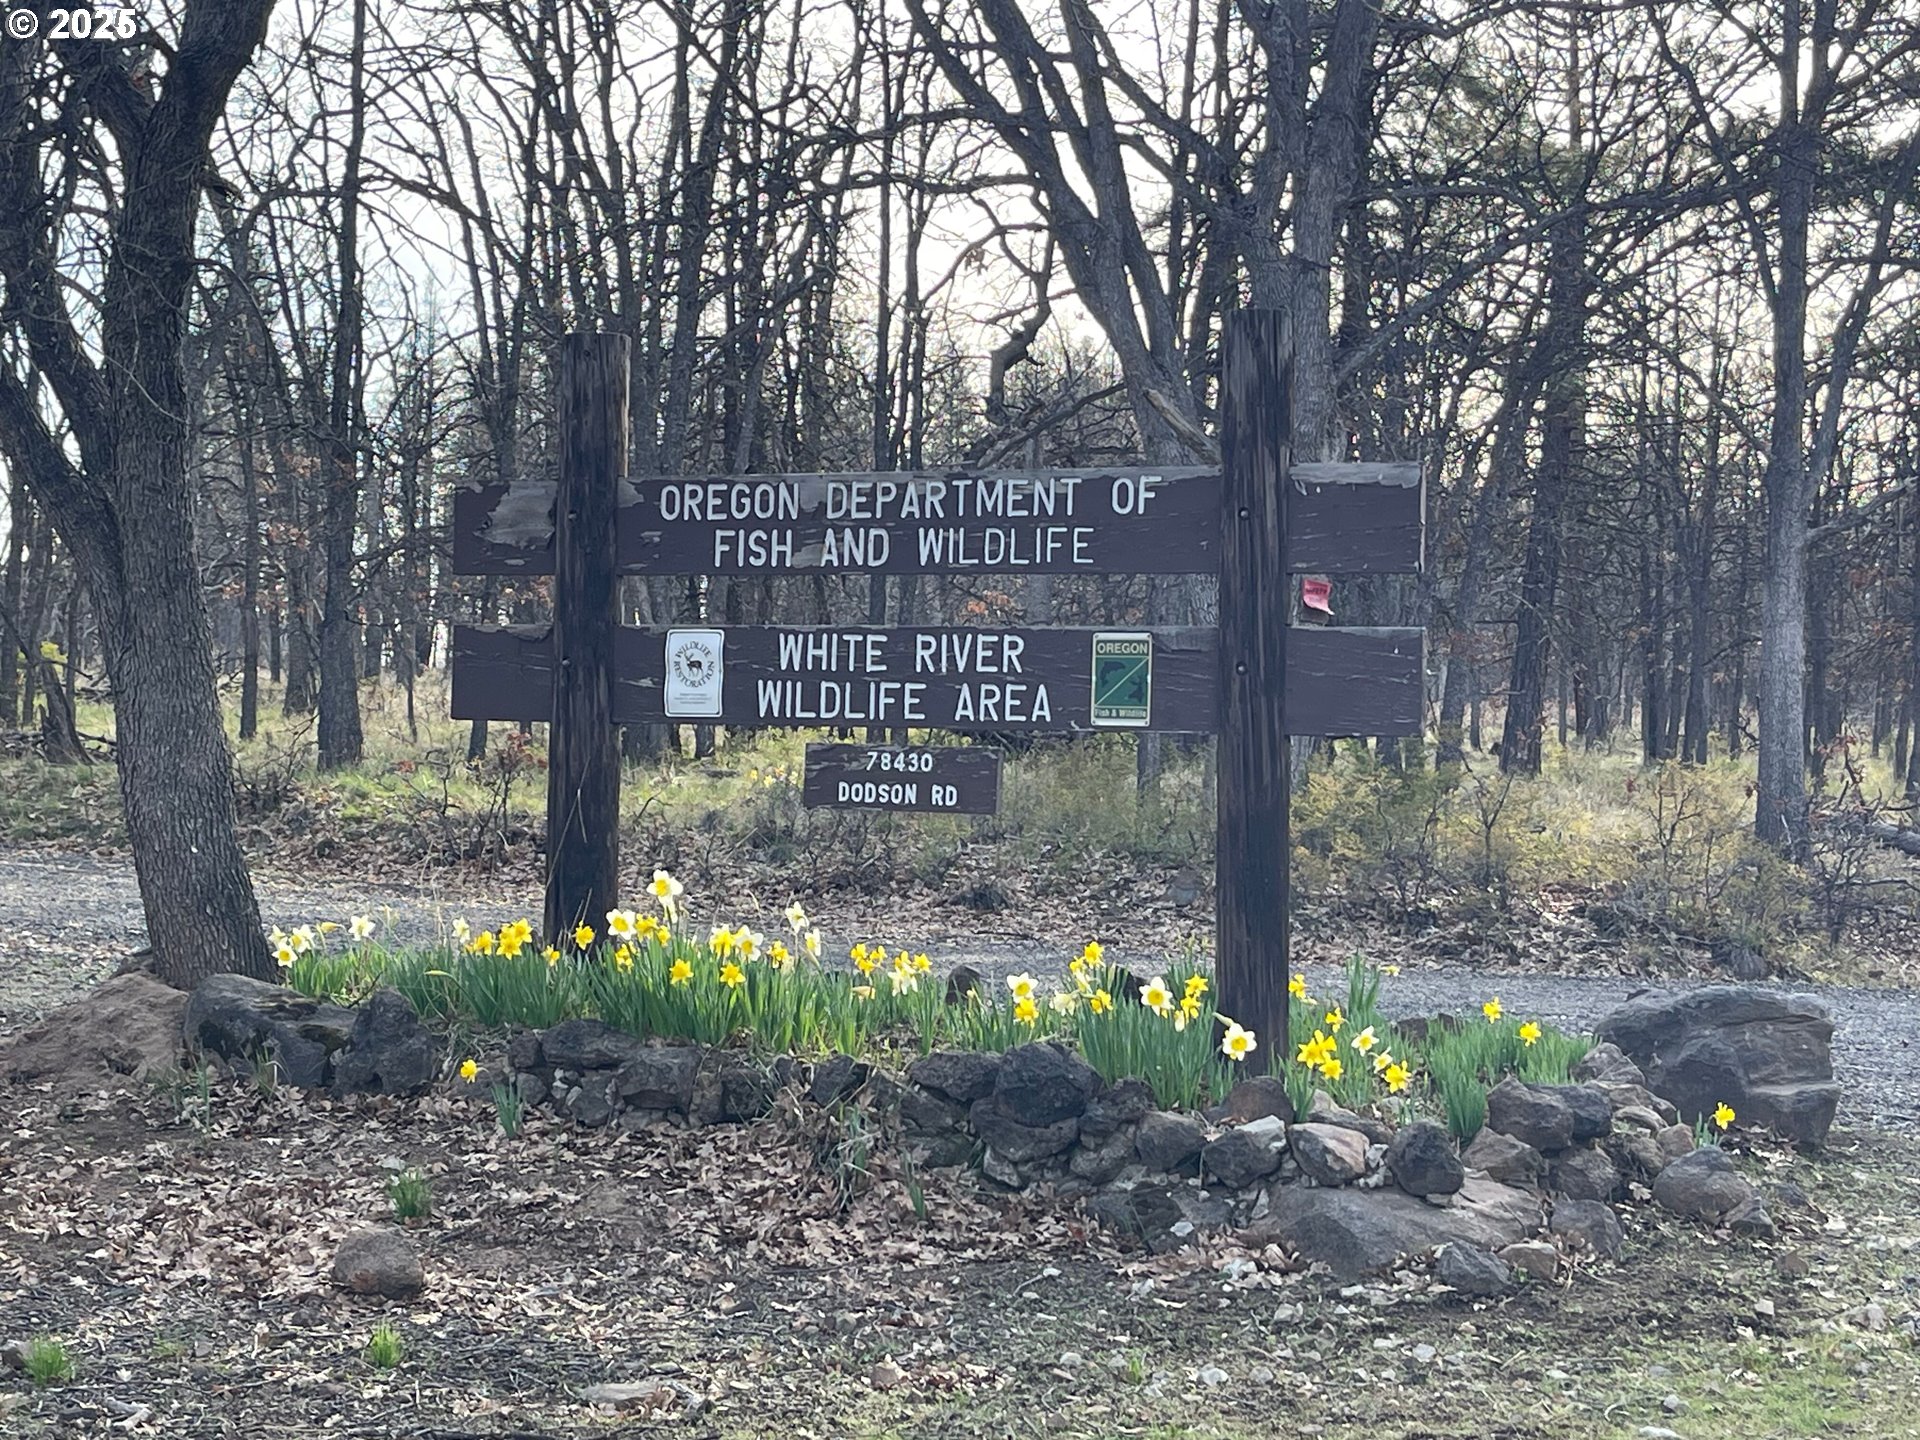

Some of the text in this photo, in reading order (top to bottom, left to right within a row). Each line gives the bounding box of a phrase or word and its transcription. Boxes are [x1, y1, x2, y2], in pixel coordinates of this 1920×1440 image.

[660, 475, 1162, 521] OREGON DEPARTMENT OF
[714, 527, 1094, 567] FISH AND WILDLIFE
[675, 641, 712, 658] WILDLIFE
[779, 633, 1025, 673] WHITE RIVER
[1097, 642, 1148, 654] OREGON
[673, 660, 715, 688] RESTORATION
[757, 679, 1052, 722] WILDLIFE AREA
[1094, 708, 1110, 717] Fish
[865, 751, 933, 772] 78430
[838, 781, 958, 807] DODSON RD
